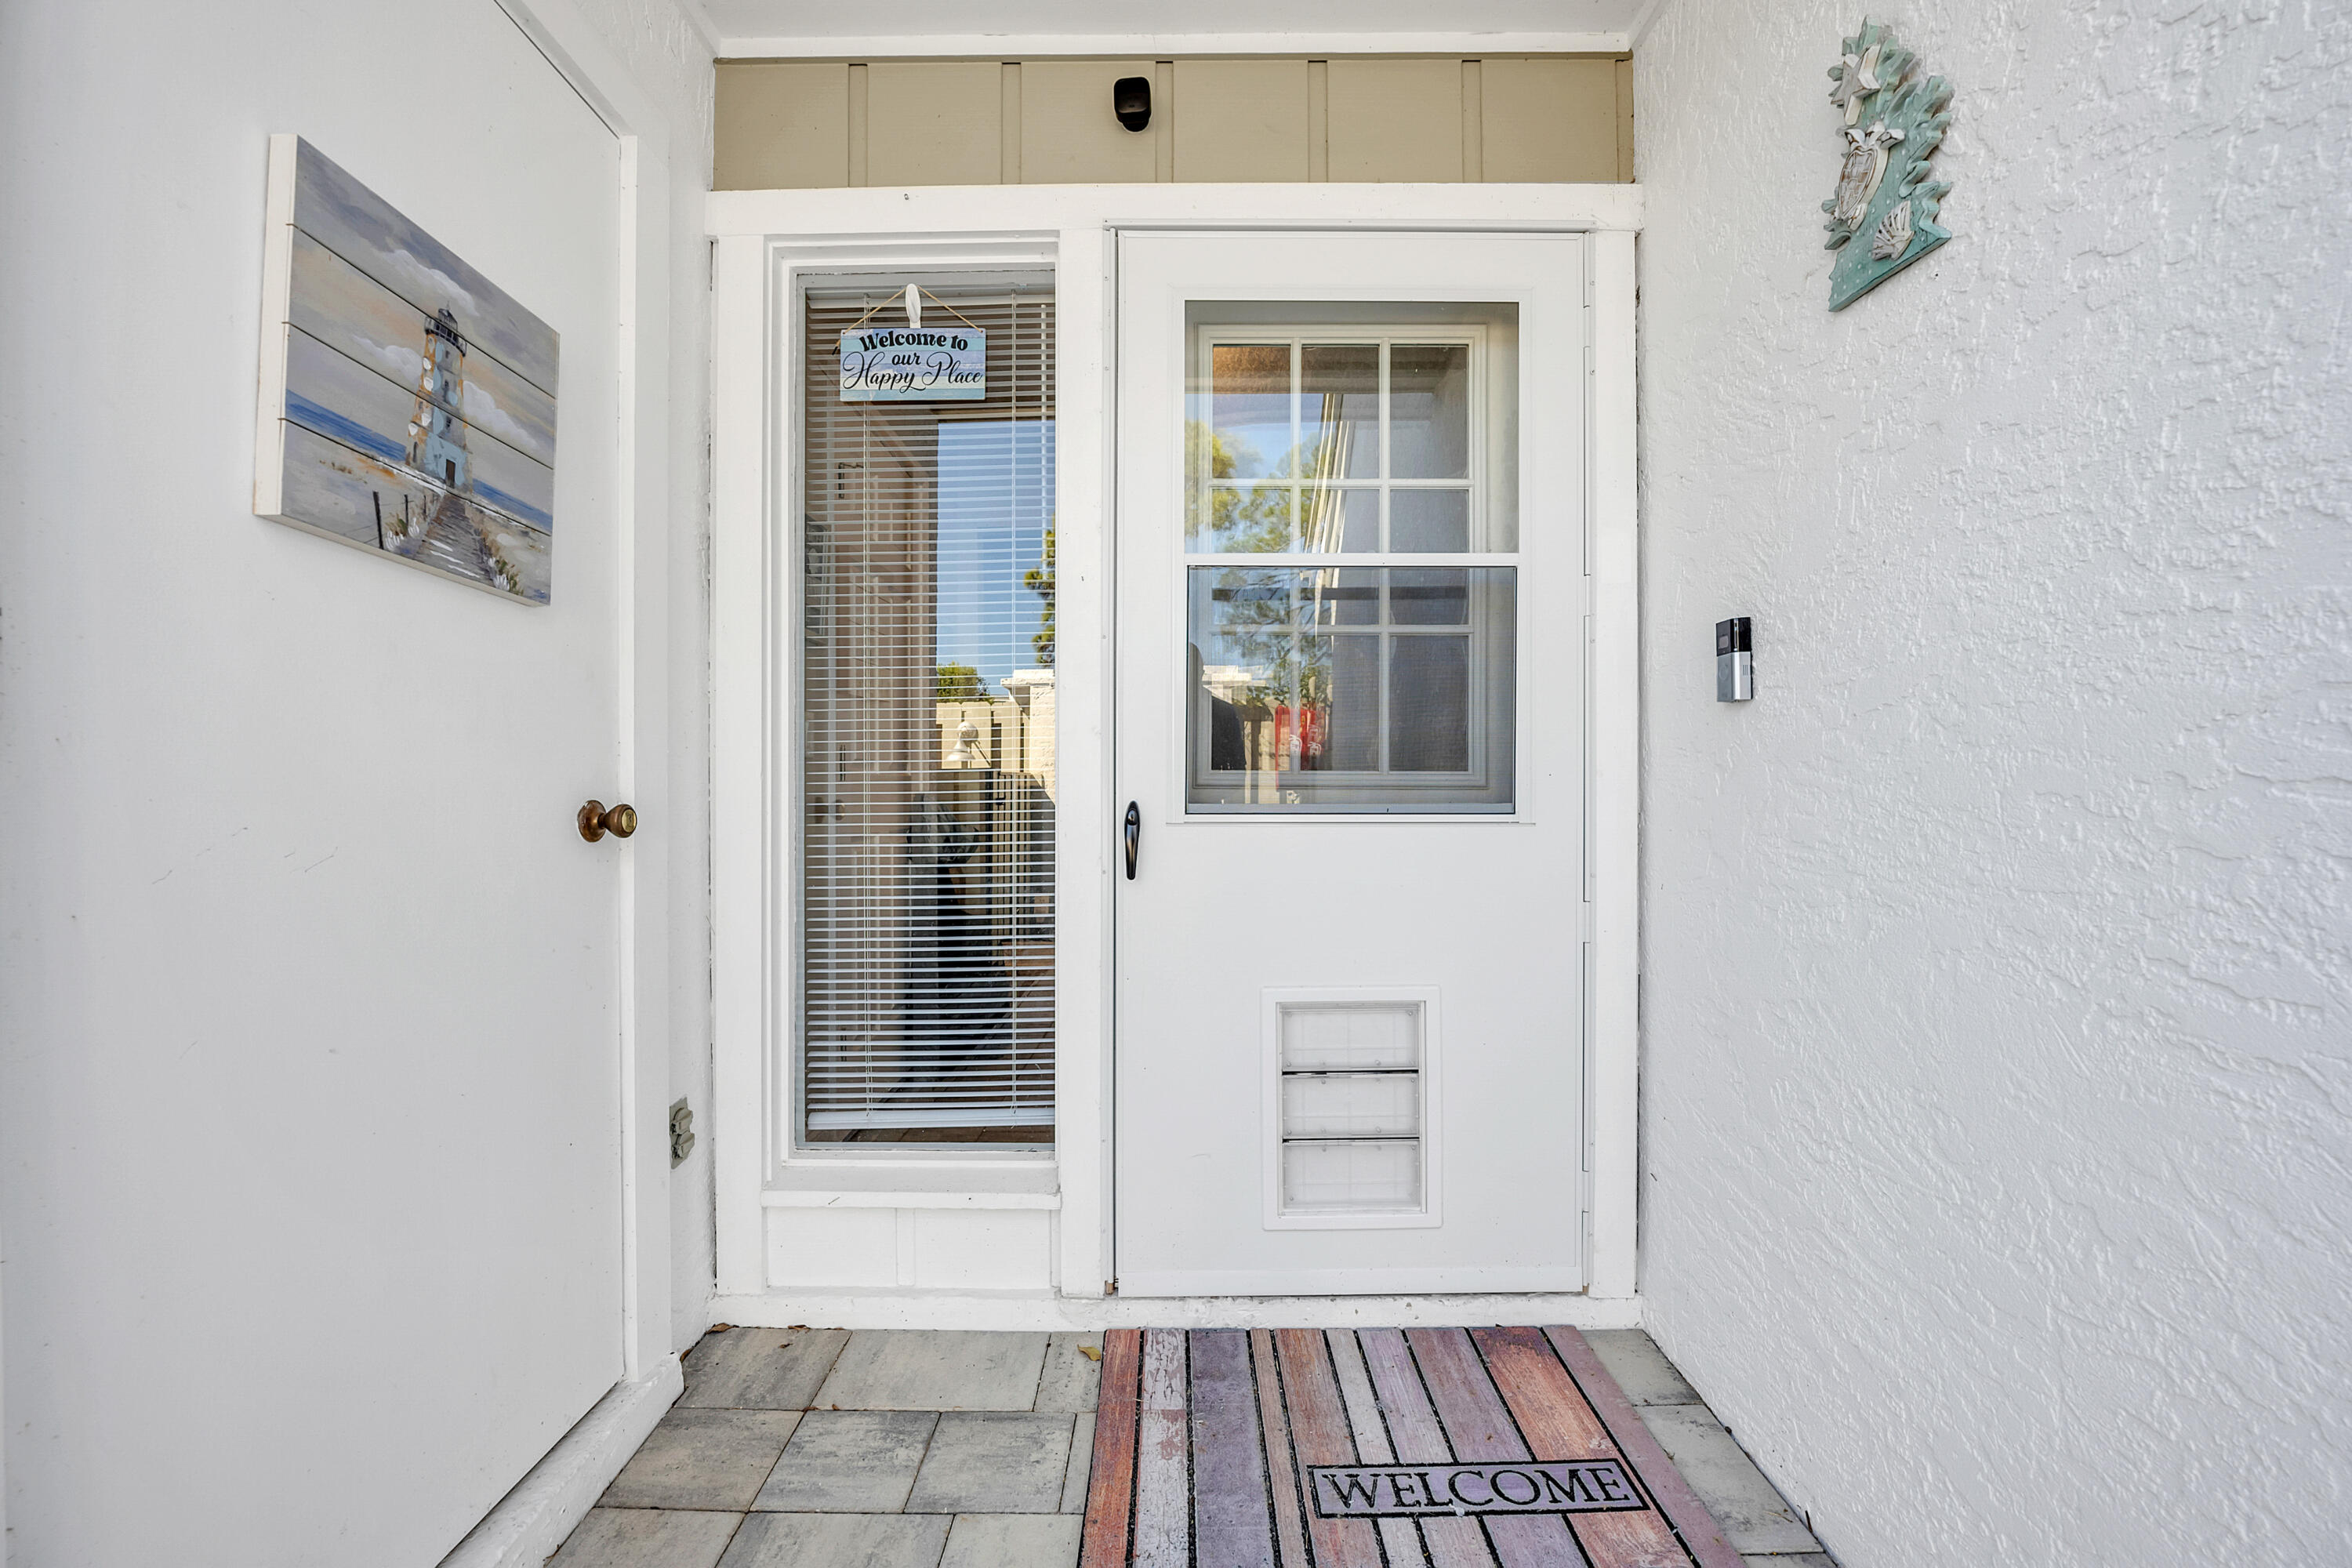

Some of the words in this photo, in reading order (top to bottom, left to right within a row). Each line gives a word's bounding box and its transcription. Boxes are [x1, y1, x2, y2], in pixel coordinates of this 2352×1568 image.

[858, 330, 947, 352] Welcome
[951, 335, 968, 351] to
[842, 351, 926, 394] Happy
[921, 351, 983, 386] Place
[891, 352, 921, 365] our
[1321, 1468, 1631, 1508] WELCOME
